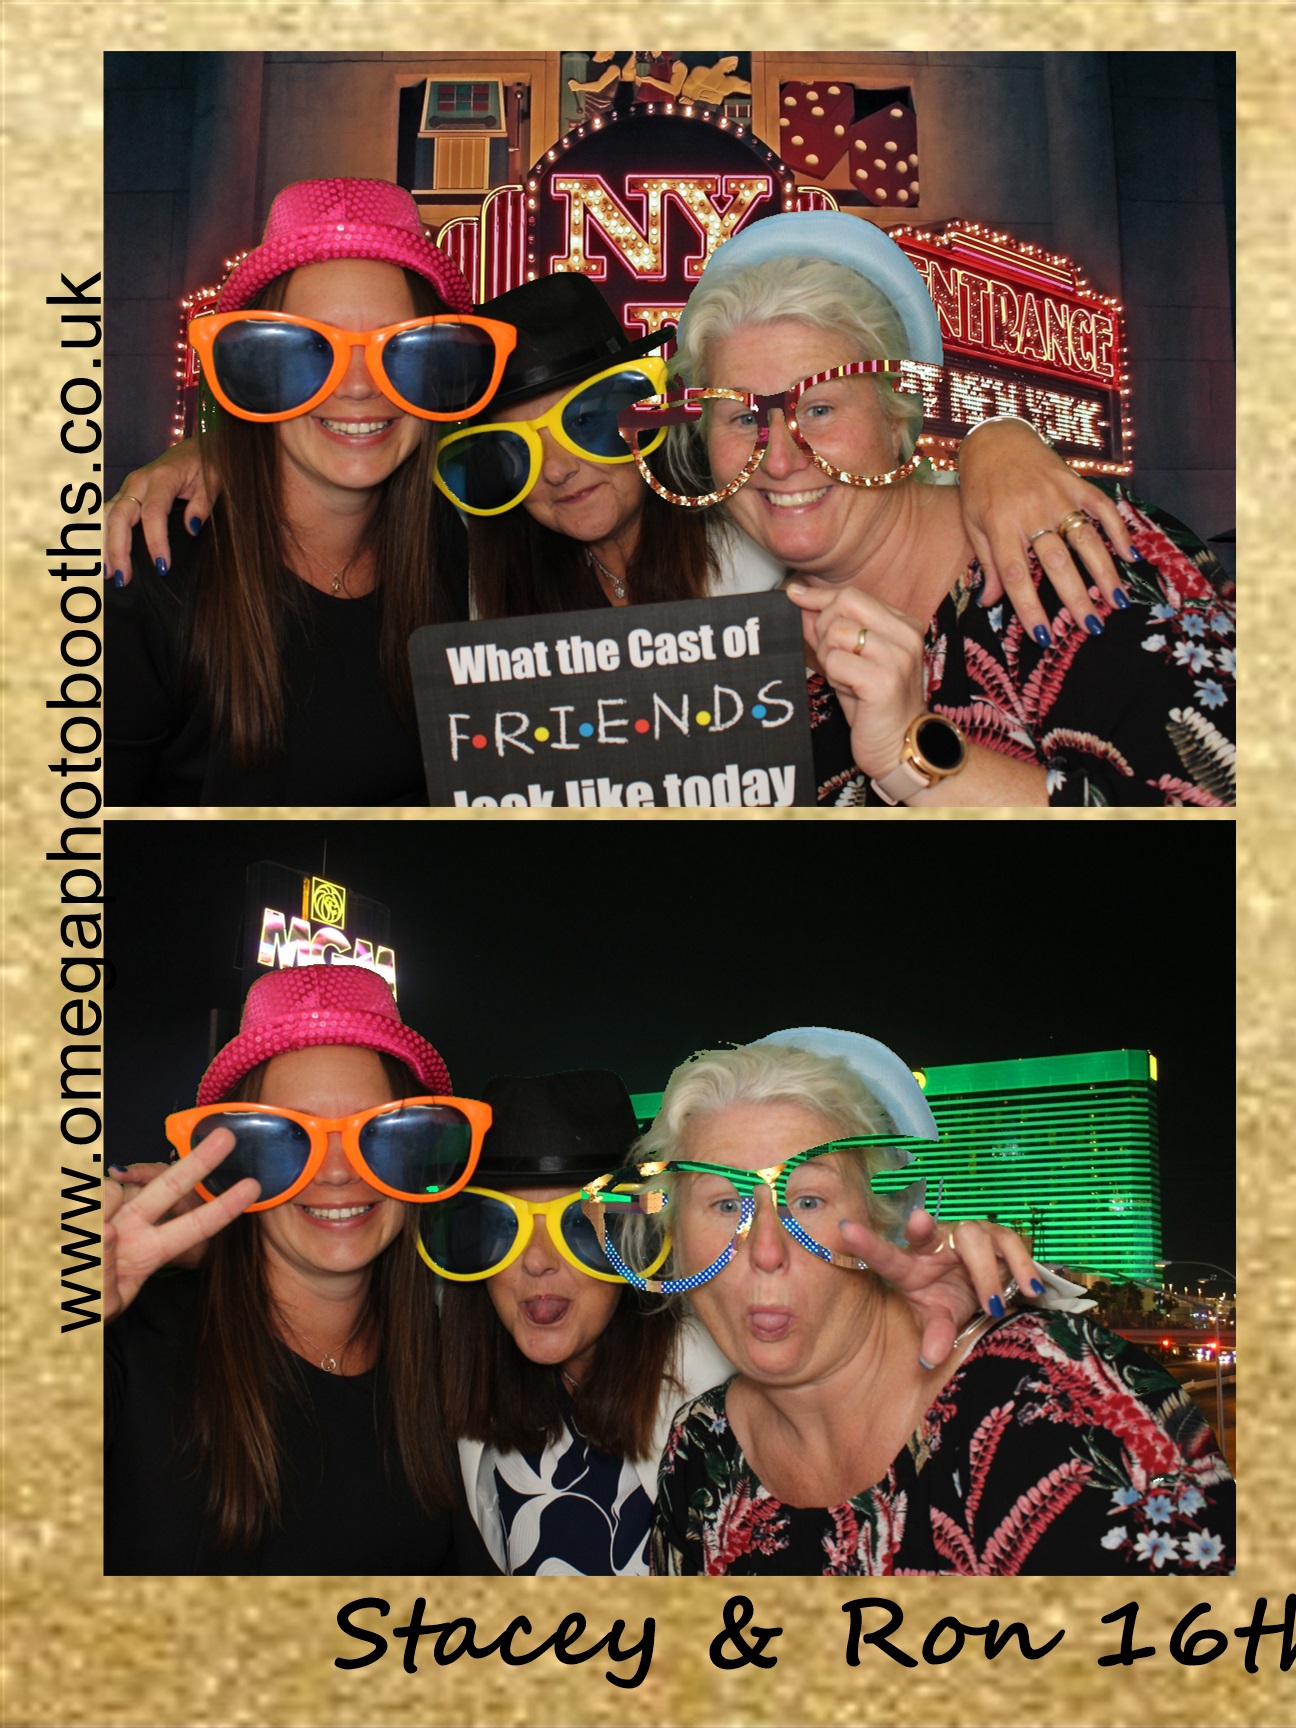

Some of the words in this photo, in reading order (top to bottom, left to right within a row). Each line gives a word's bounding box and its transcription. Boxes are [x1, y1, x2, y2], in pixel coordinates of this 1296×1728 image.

[551, 174, 772, 281] NY
[446, 642, 552, 686] What
[555, 636, 621, 675] the
[628, 624, 717, 669] Cast
[722, 617, 761, 659] of
[565, 777, 655, 807] like
[662, 764, 796, 807] today
[257, 907, 397, 1000] MGM
